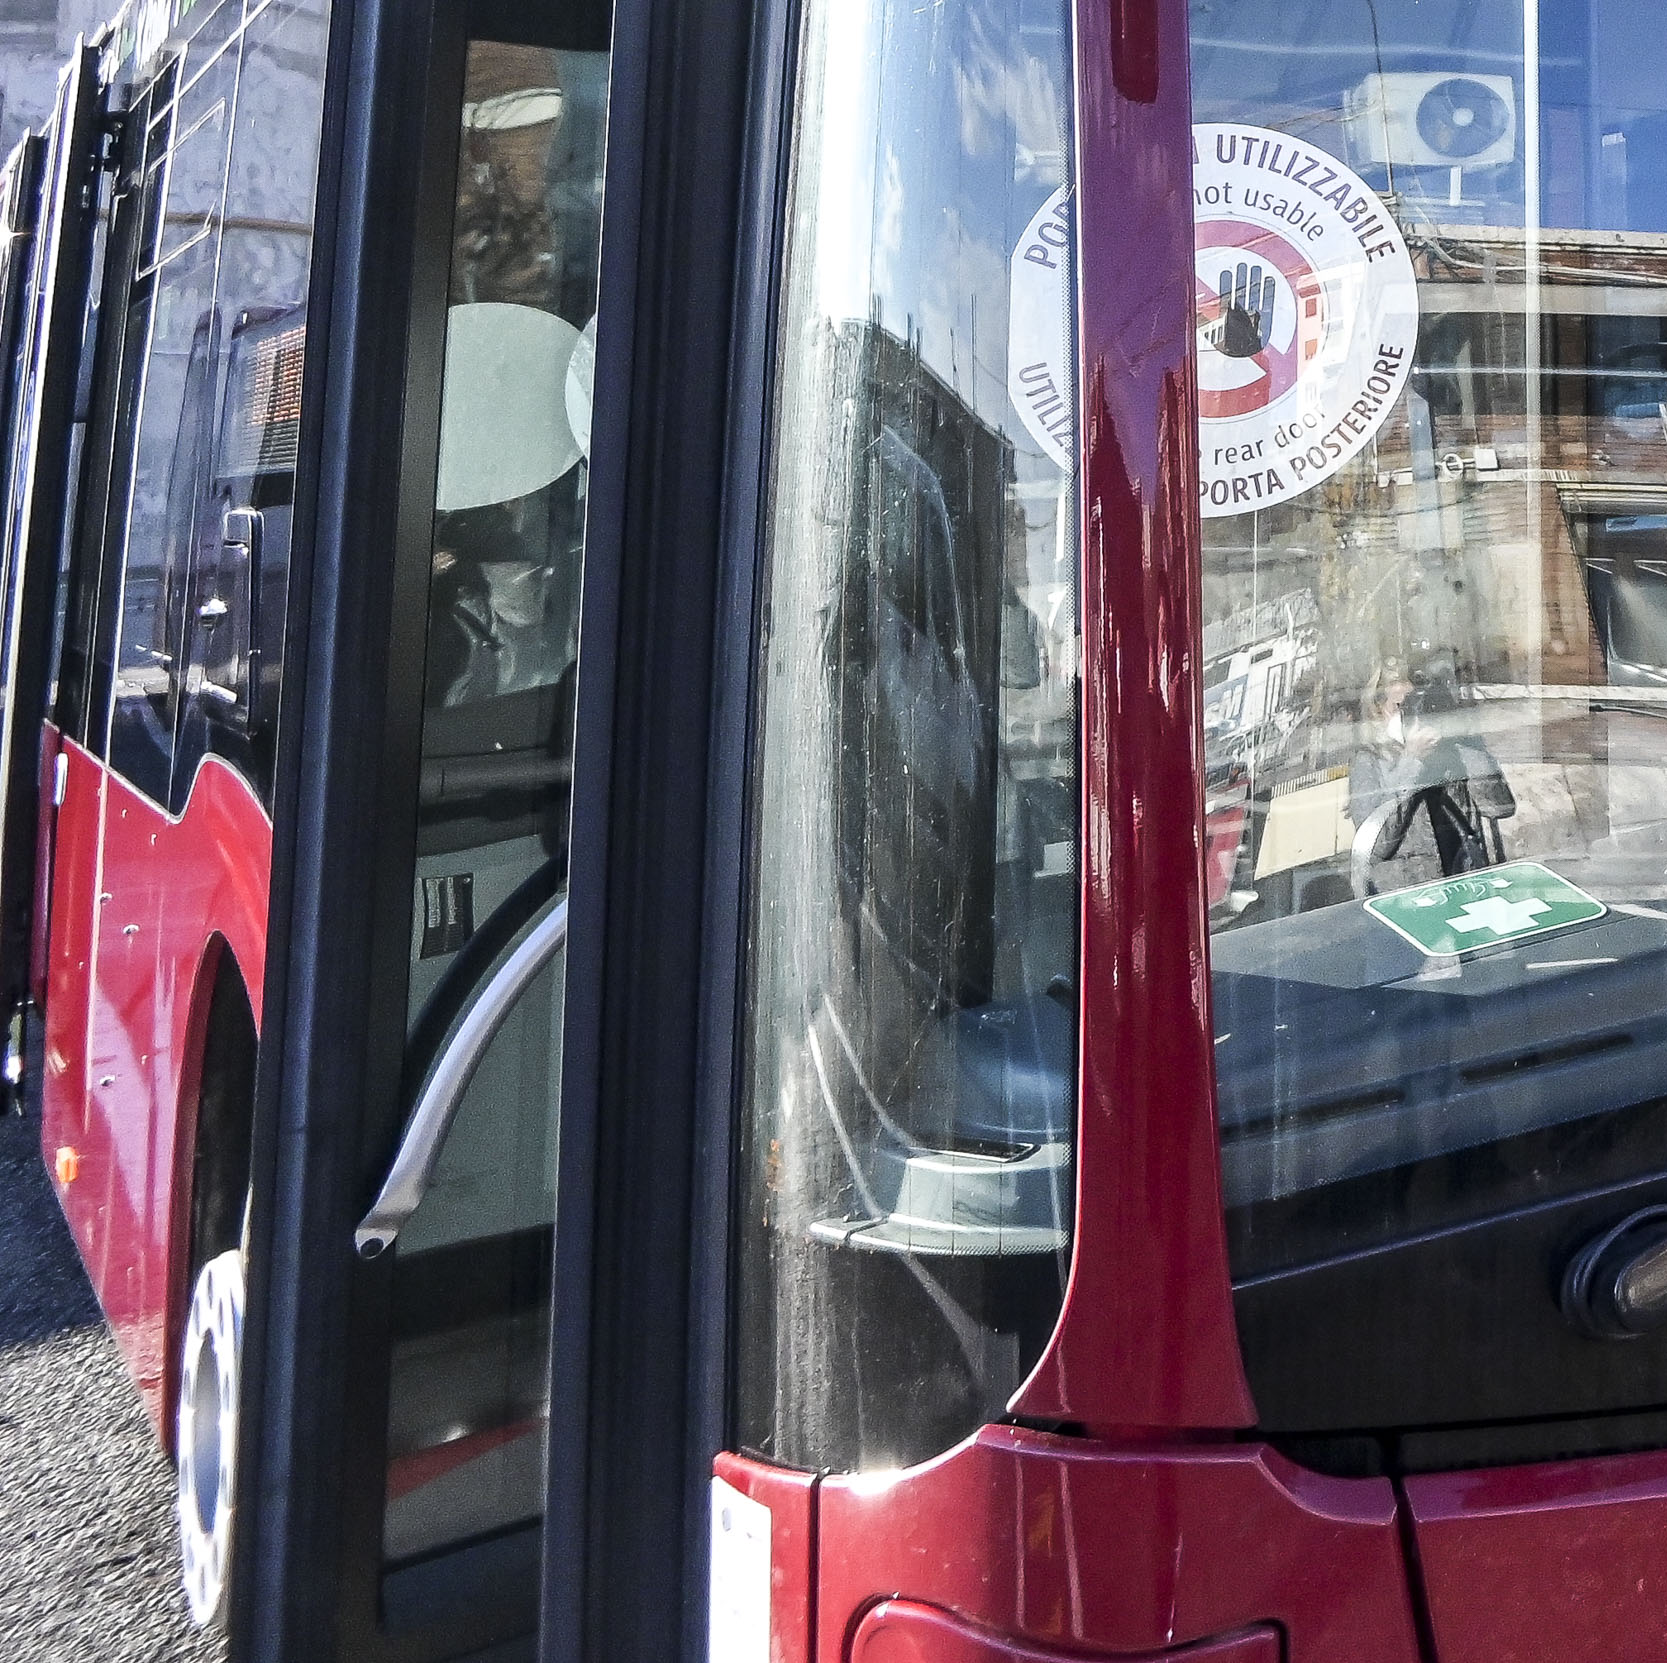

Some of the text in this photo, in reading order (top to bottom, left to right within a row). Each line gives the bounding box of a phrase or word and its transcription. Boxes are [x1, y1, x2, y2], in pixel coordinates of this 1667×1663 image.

[1216, 134, 1395, 262] UTILIZZABILE
[1244, 187, 1324, 242] usable
[1214, 405, 1326, 466] rear door
[1289, 344, 1404, 480] POSTERIORE
